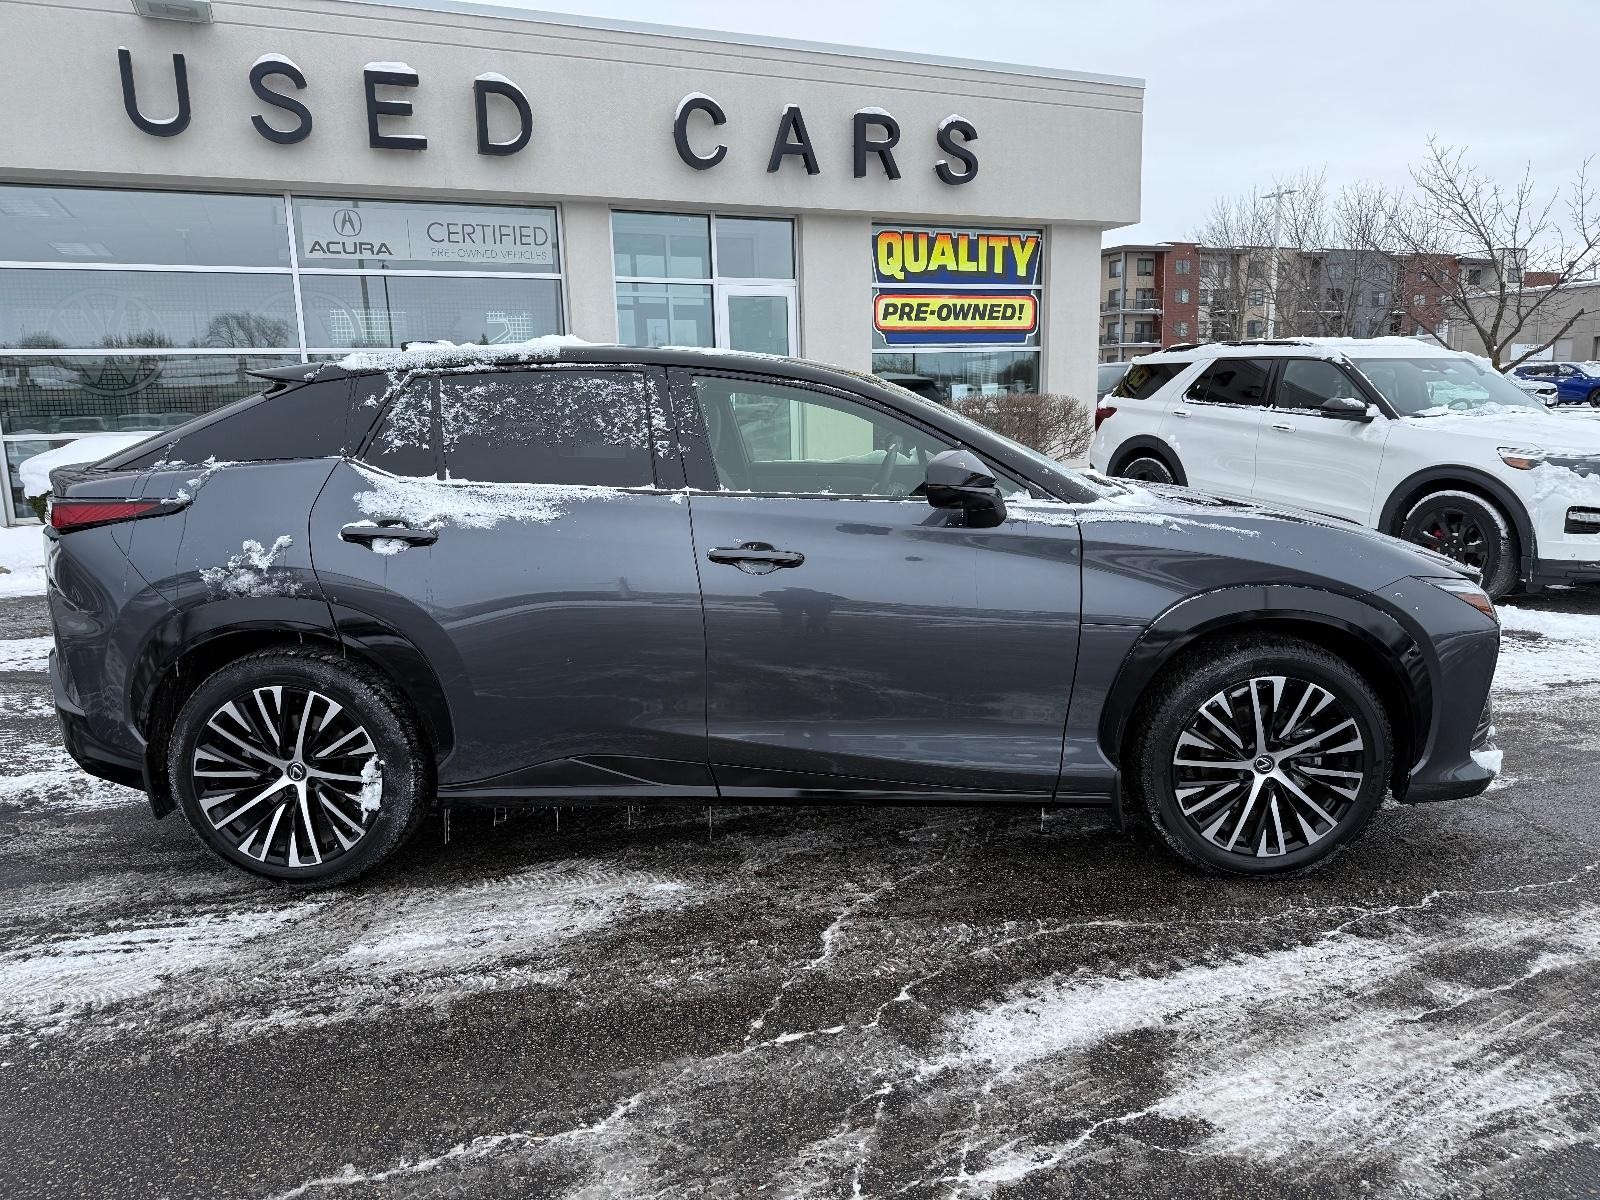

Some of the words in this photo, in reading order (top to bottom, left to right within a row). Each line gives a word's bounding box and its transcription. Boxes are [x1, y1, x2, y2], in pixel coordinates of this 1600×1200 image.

[117, 47, 533, 156] USED
[673, 95, 979, 186] CARS
[426, 221, 549, 247] CERTIFIED
[308, 240, 394, 256] ACURA
[430, 247, 498, 259] PRE-OWNED
[877, 230, 1040, 280] QUALITY
[881, 302, 1026, 322] PRE-OWNED!
